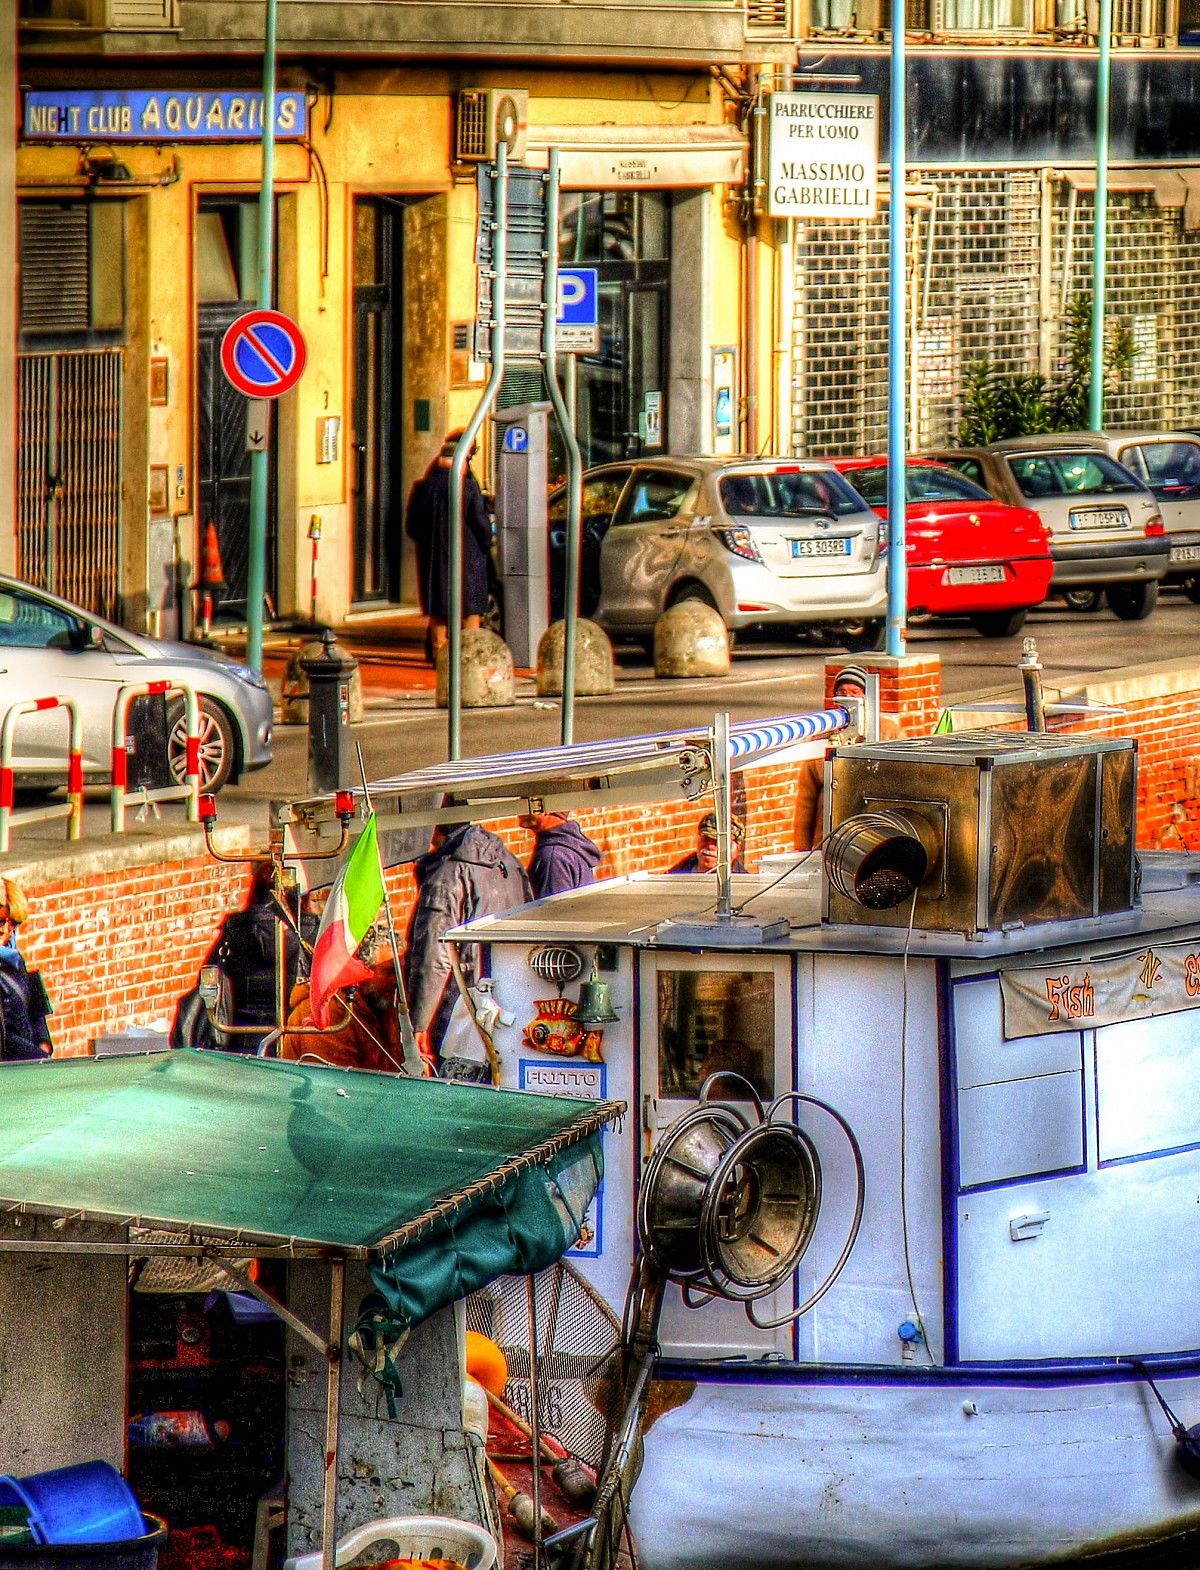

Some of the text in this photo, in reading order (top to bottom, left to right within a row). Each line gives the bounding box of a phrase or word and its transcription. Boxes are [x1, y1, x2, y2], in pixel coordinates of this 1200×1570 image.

[29, 105, 80, 132] NIGHT
[88, 105, 131, 132] CLUB
[774, 102, 875, 119] PARRUCCHIERE
[788, 124, 859, 139] PER UOMO
[780, 162, 865, 181] MASSIMO
[774, 186, 870, 206] GABRIELLI
[556, 274, 586, 320] P
[511, 428, 526, 450] P
[1046, 972, 1095, 1020] Fish
[526, 1070, 598, 1086] FRITTO
